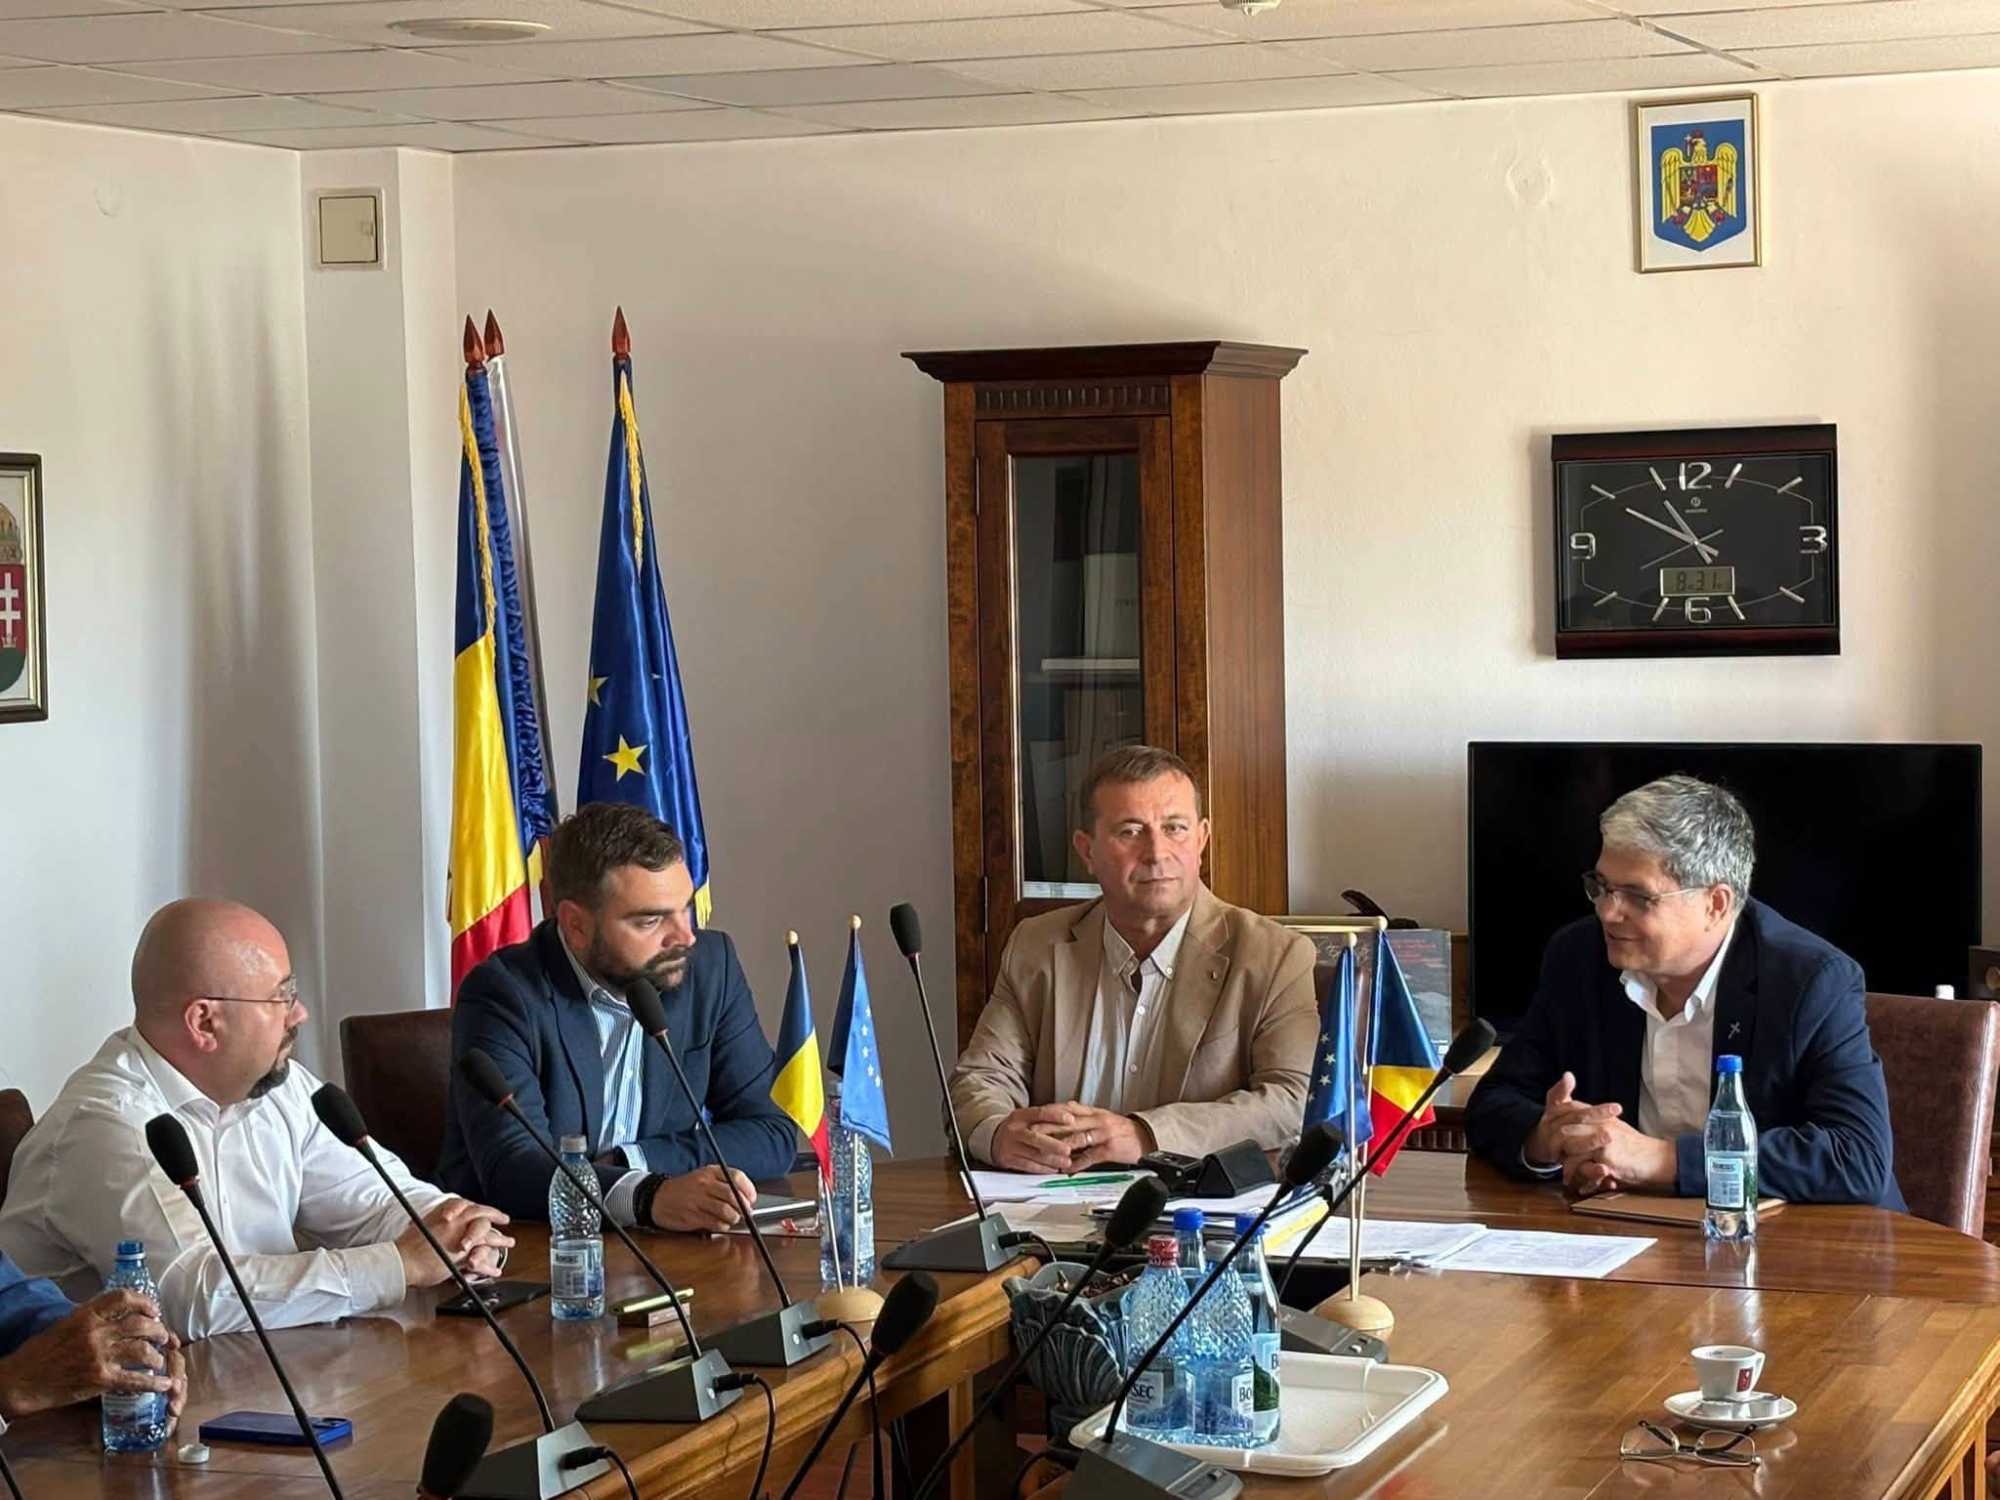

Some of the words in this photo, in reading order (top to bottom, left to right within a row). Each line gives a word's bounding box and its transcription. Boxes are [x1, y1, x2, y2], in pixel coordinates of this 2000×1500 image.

[1679, 462, 1712, 490] 12
[1570, 532, 1596, 560] 9
[1799, 525, 1827, 554] 3
[1685, 596, 1711, 623] 6
